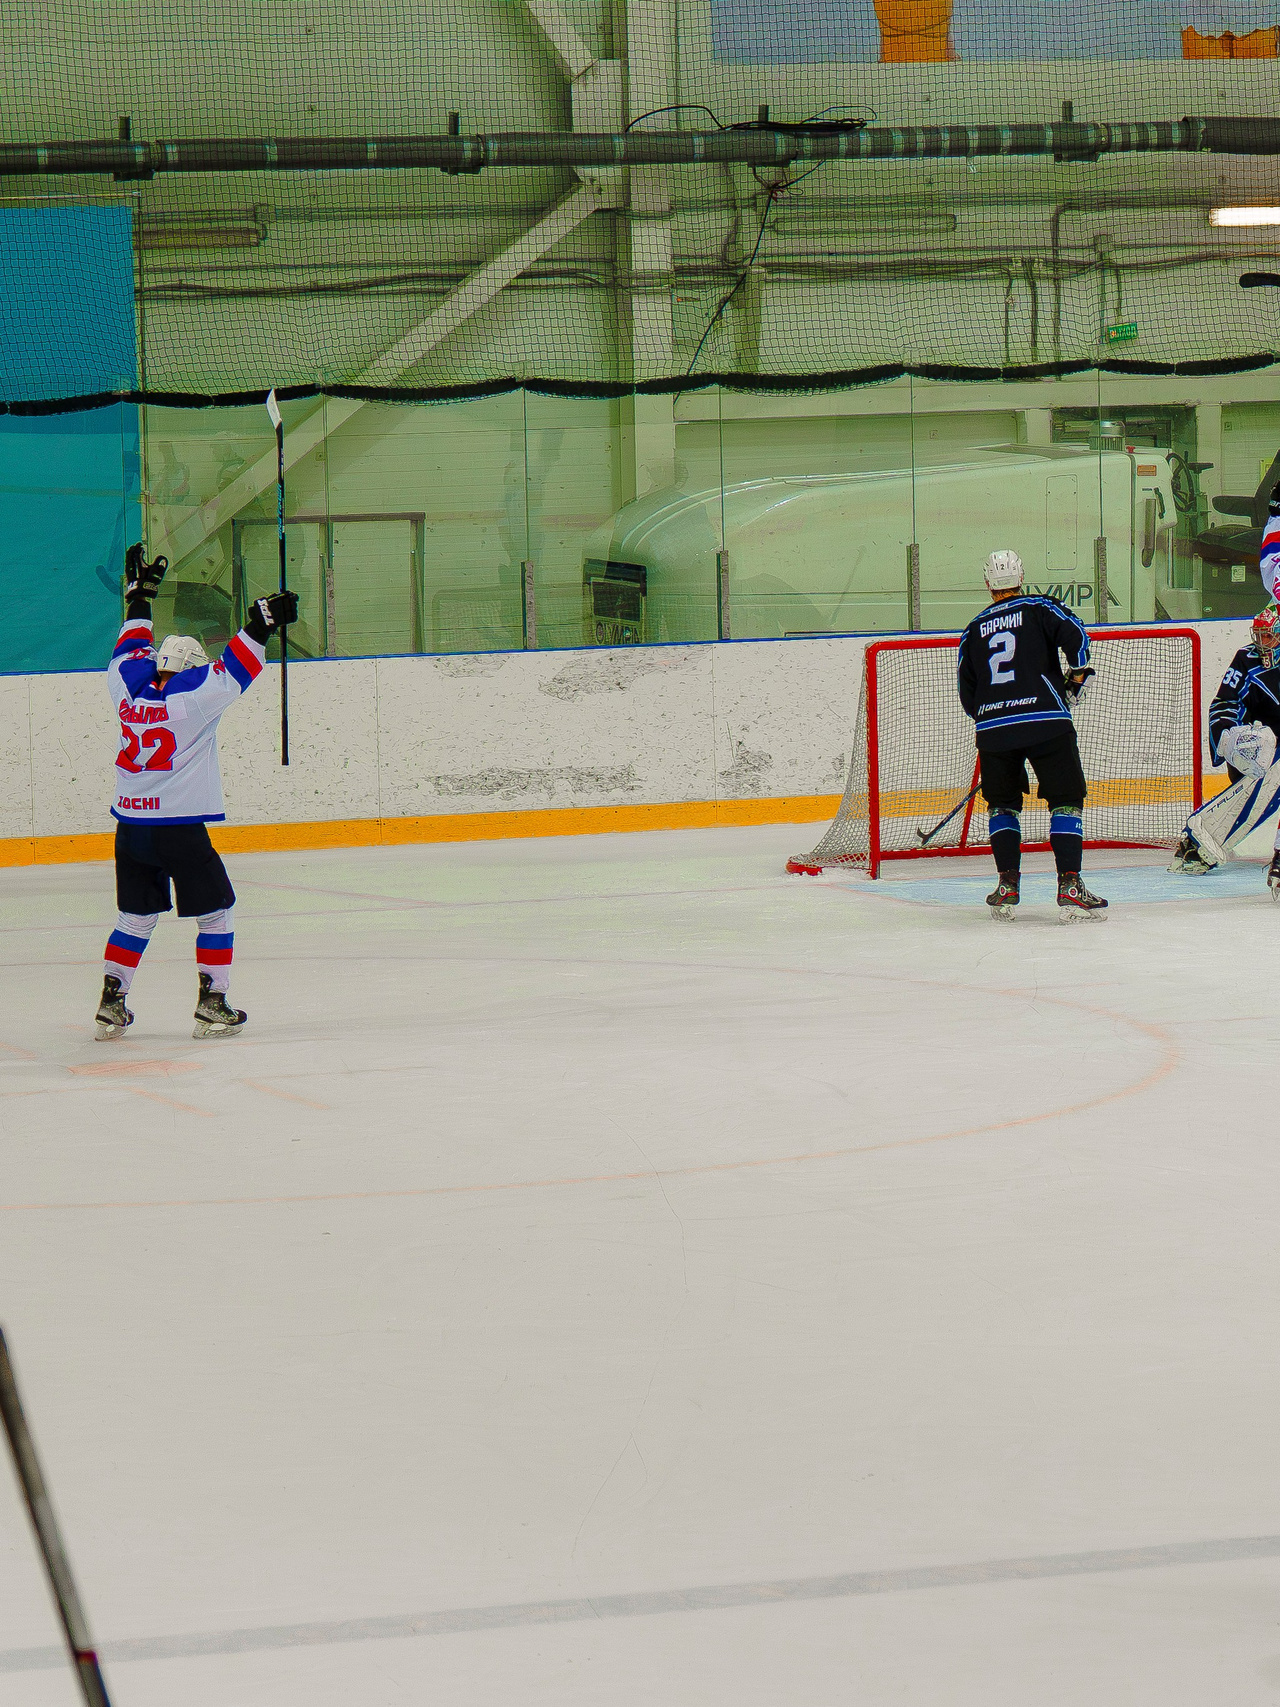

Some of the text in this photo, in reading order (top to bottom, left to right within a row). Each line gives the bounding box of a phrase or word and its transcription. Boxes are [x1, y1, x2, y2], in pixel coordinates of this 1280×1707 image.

[979, 611, 1023, 638] БАРМИН
[988, 631, 1016, 685] 2
[1222, 667, 1243, 689] 35
[985, 696, 1038, 712] ONE TIMER
[115, 721, 177, 774] 22
[1206, 784, 1244, 814] TRUE
